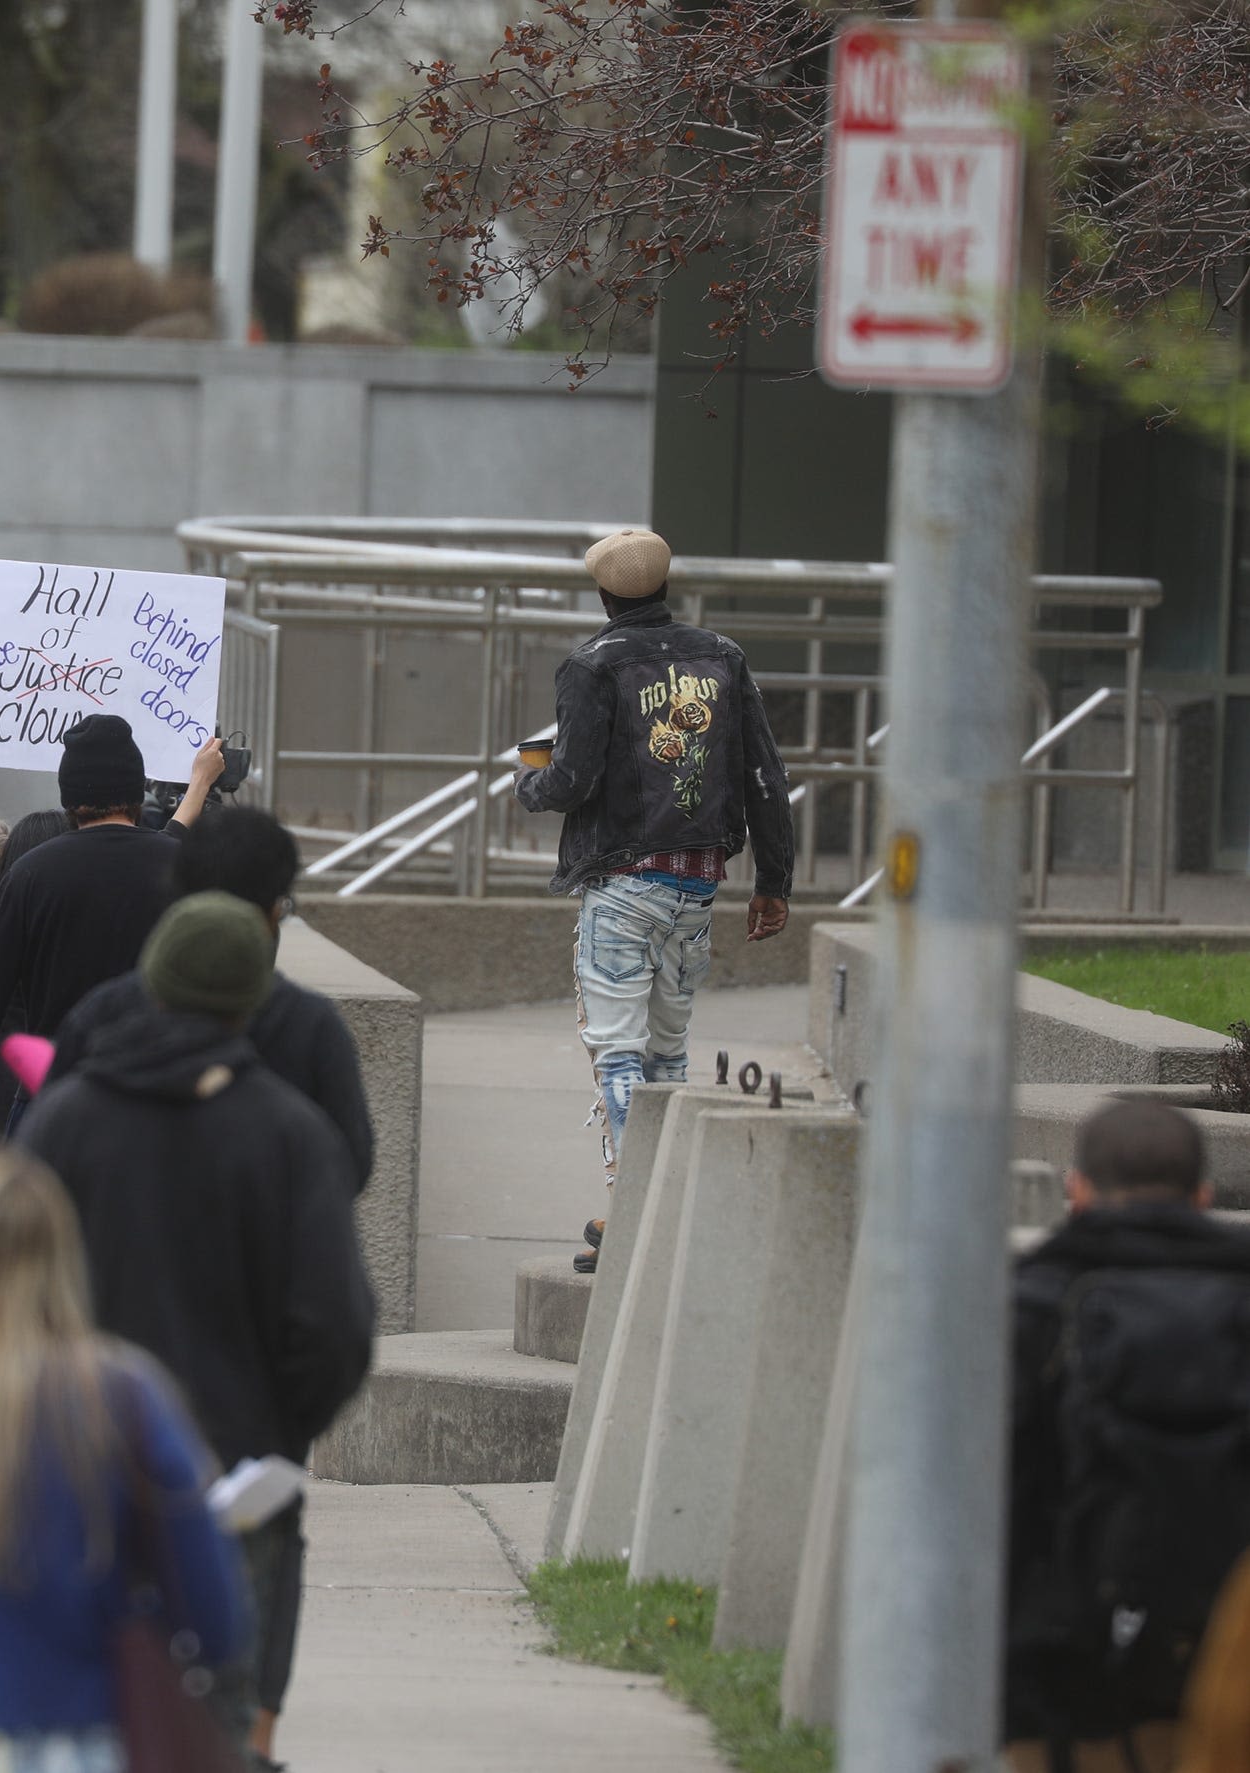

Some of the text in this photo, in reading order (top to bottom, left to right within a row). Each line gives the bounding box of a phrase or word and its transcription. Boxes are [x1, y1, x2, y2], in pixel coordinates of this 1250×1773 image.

[871, 153, 979, 208] ANY
[863, 224, 979, 294] TIME
[20, 565, 114, 617] Hall
[40, 616, 89, 650] of
[133, 591, 221, 666] Behind
[0, 646, 123, 696] Justice
[130, 638, 200, 695] closed
[140, 684, 209, 748] doors
